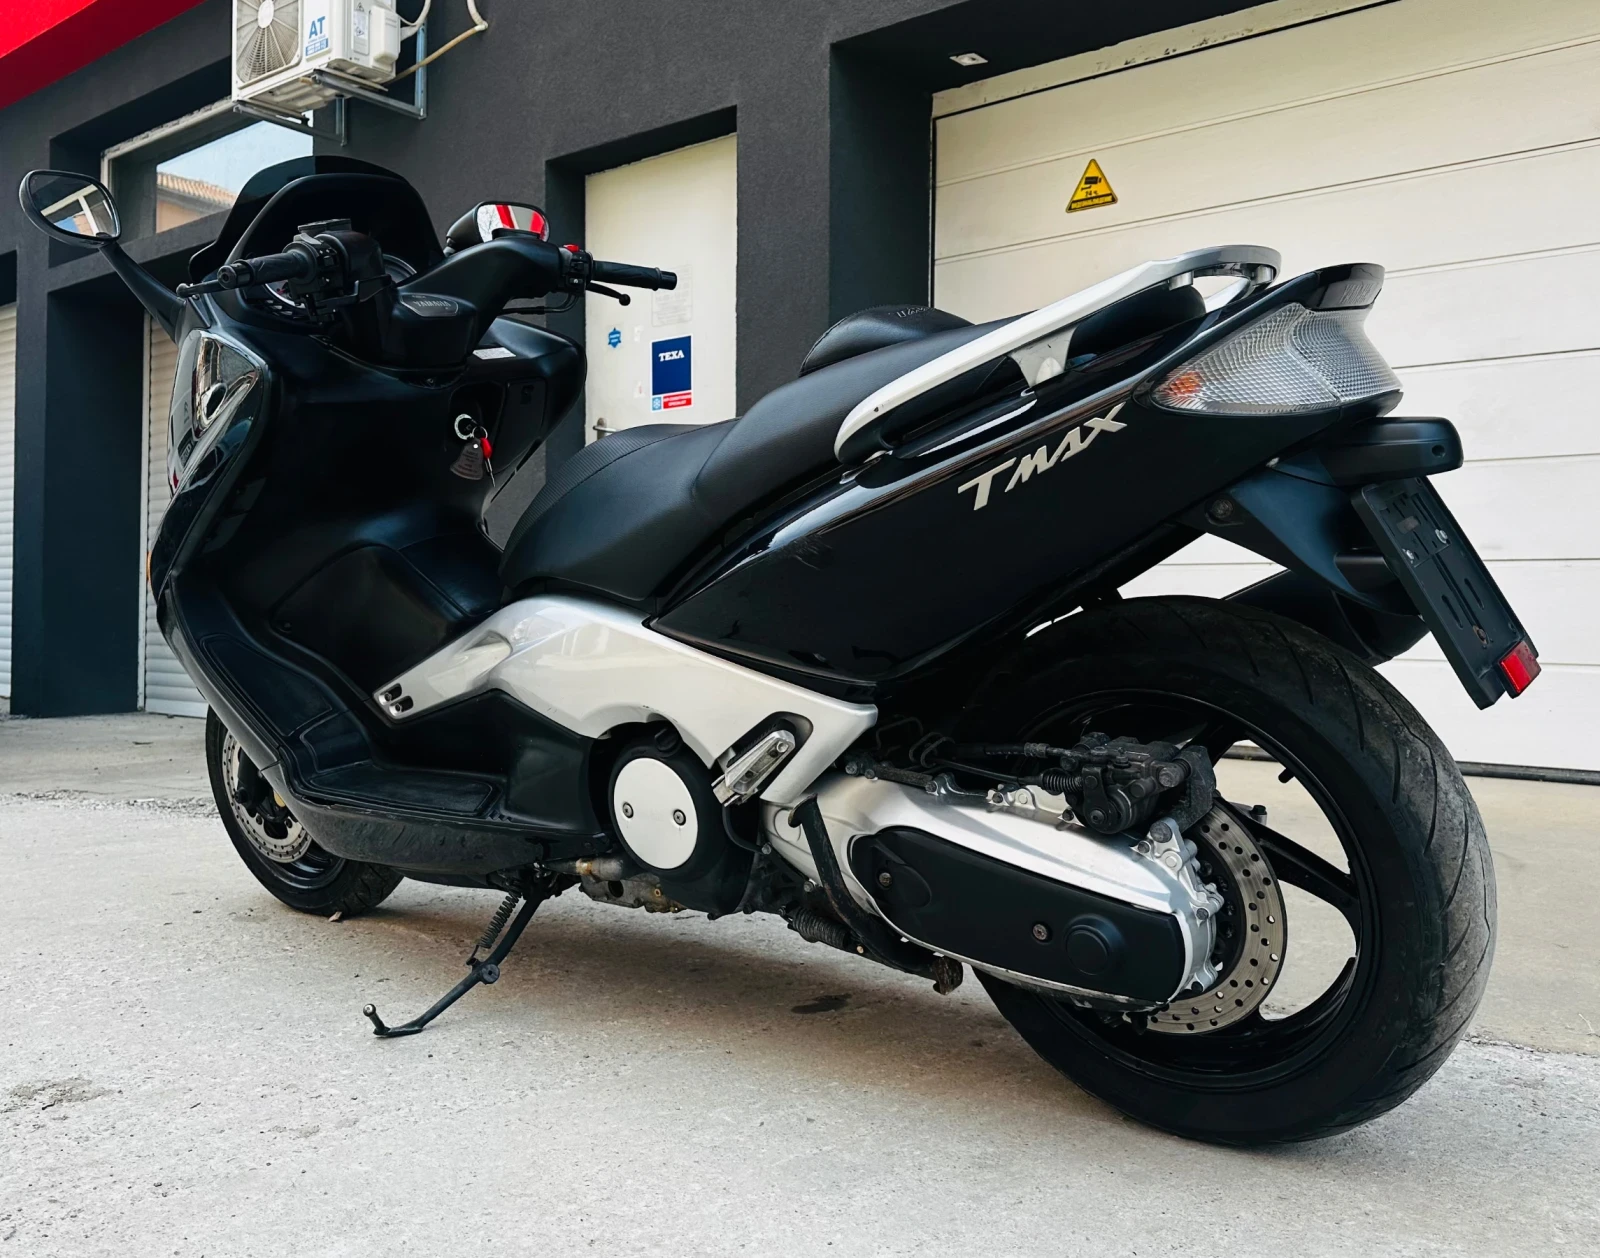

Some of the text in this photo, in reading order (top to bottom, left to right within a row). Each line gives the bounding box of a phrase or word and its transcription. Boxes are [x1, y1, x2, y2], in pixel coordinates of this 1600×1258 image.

[309, 16, 326, 39] AT
[658, 349, 685, 362] TEXA
[958, 402, 1127, 511] TMAX
